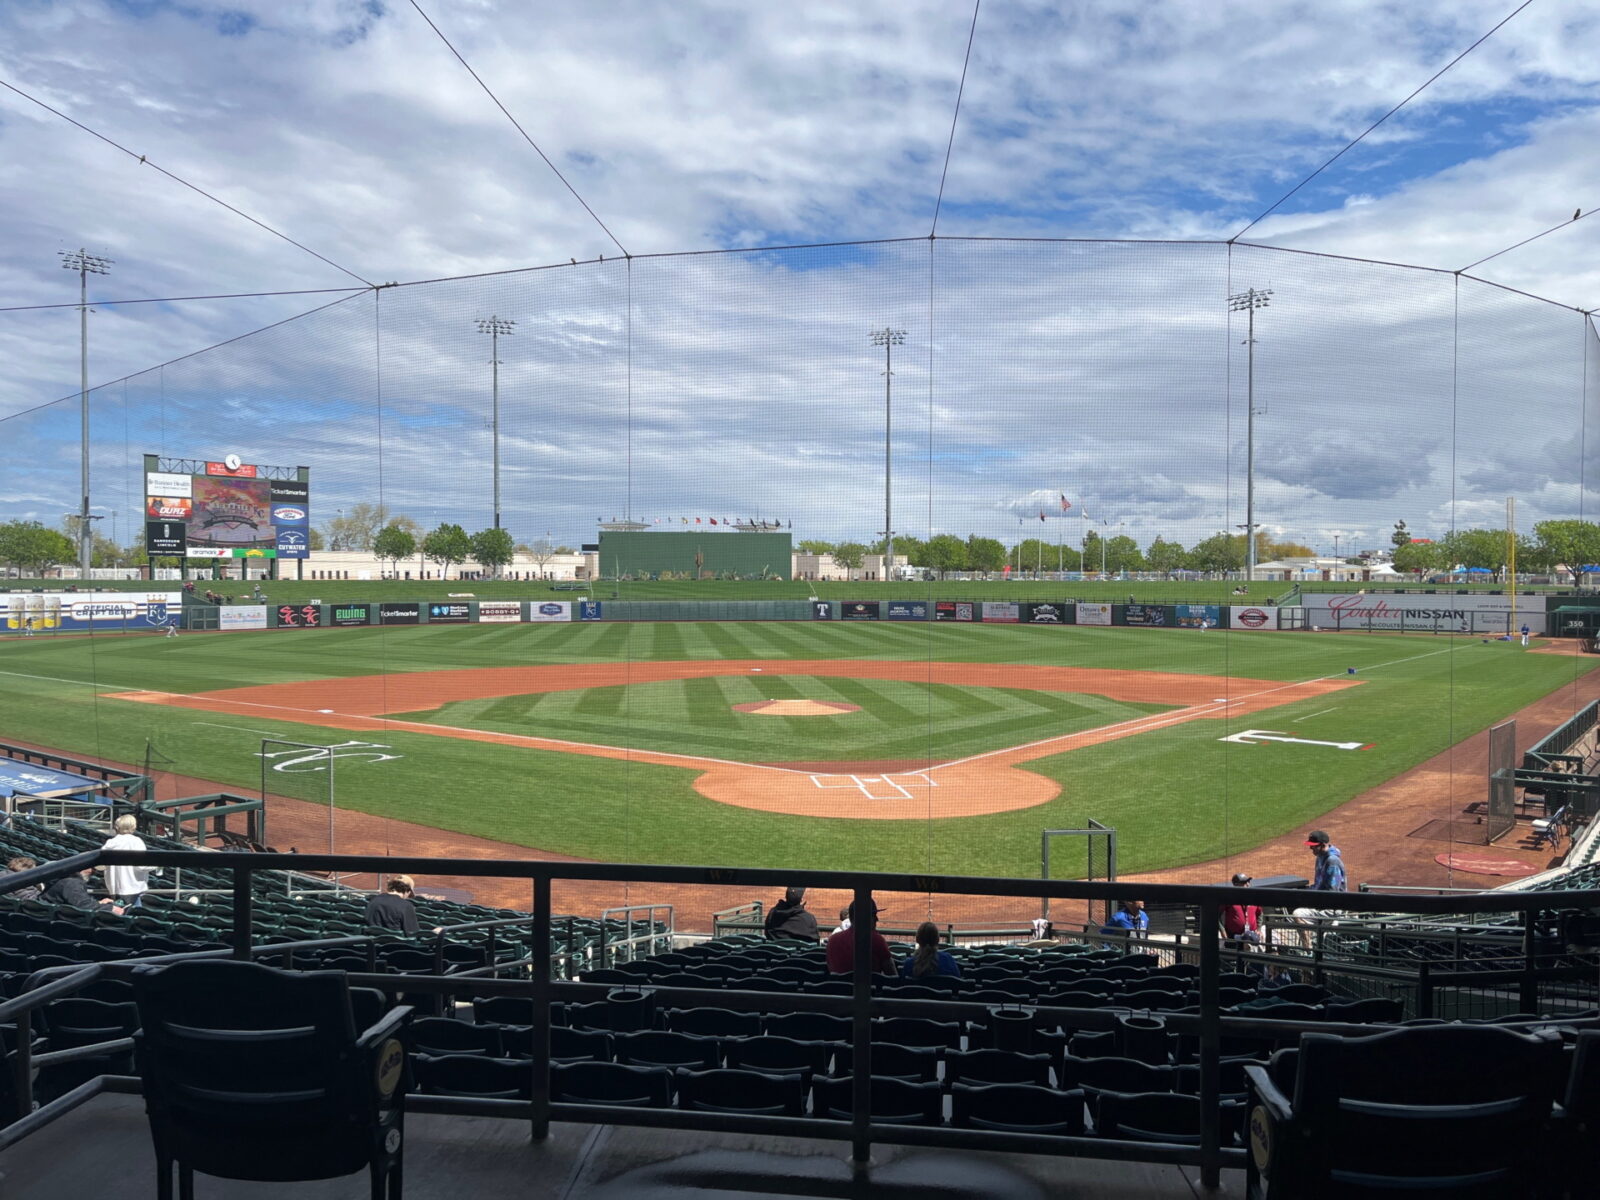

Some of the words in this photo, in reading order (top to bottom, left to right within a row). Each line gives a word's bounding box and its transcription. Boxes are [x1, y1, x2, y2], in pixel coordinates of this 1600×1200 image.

[271, 488, 307, 496] TicketSmarter
[817, 603, 829, 617] T
[1328, 595, 1401, 620] Coulter
[1405, 608, 1465, 619] NISSAN
[1568, 620, 1584, 628] 350
